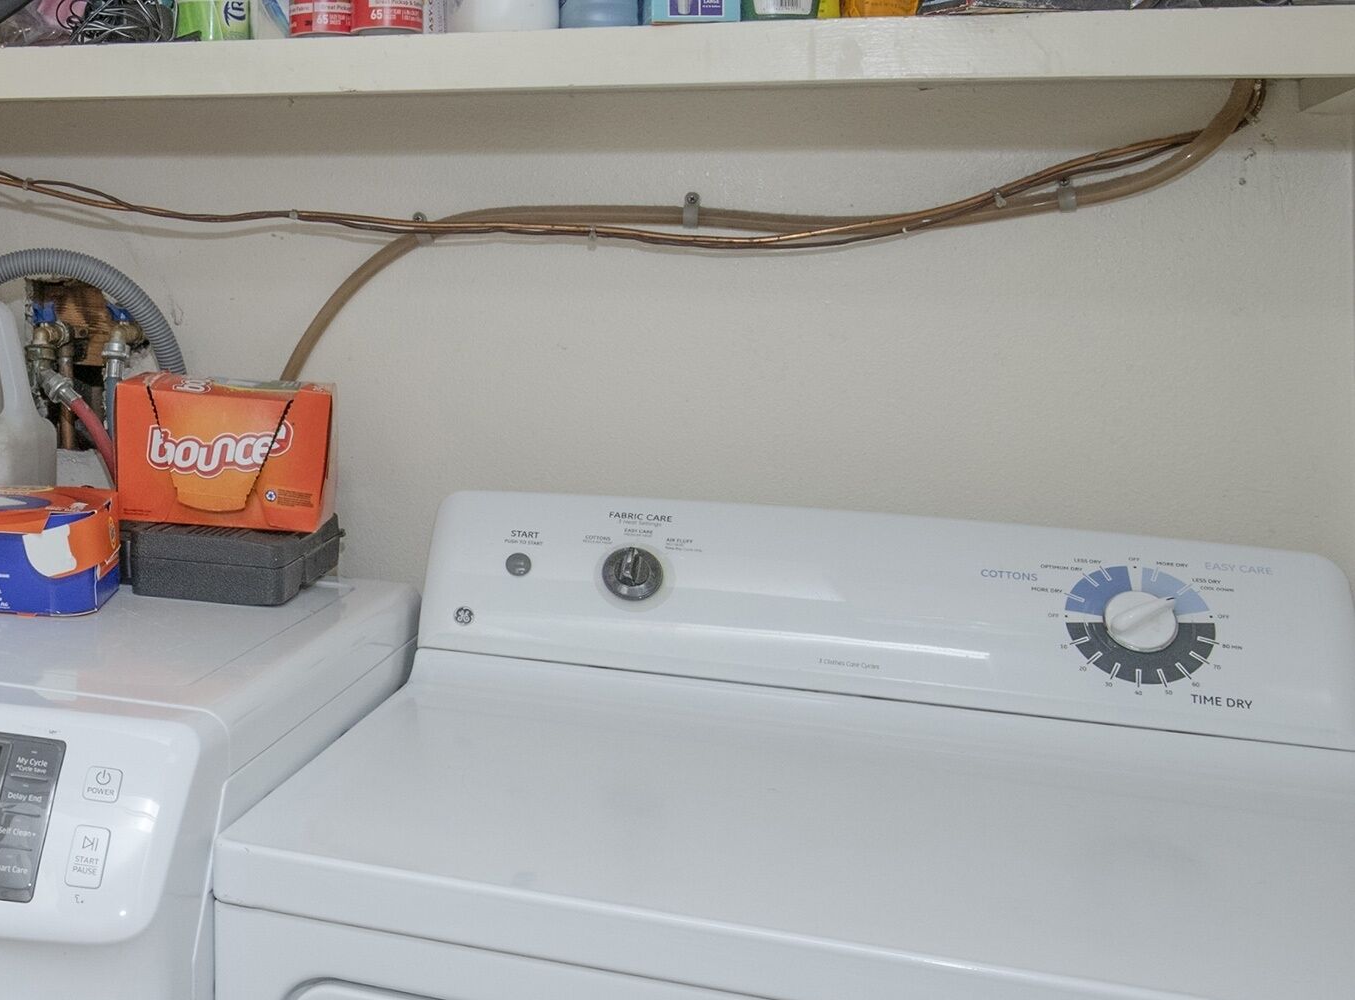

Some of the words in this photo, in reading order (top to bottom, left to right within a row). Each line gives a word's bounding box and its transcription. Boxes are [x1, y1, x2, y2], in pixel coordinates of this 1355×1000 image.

[316, 14, 329, 25] 65
[370, 9, 384, 20] 65
[149, 424, 286, 473] bounce
[609, 511, 644, 521] FABRIC
[646, 513, 673, 523] CARE
[510, 530, 540, 539] START
[1156, 560, 1175, 568] MORE
[1204, 561, 1236, 573] EASY
[1239, 564, 1274, 576] CARE
[980, 568, 1039, 582] COTTONS
[1191, 693, 1222, 707] TIME
[1226, 697, 1253, 710] DRY
[16, 756, 28, 765] My
[29, 758, 48, 768] Cycle
[86, 786, 115, 796] POWER
[7, 791, 27, 802] Delay
[28, 794, 43, 803] End
[74, 855, 99, 865] START
[11, 865, 28, 874] Care
[72, 865, 97, 876] PAUSE
